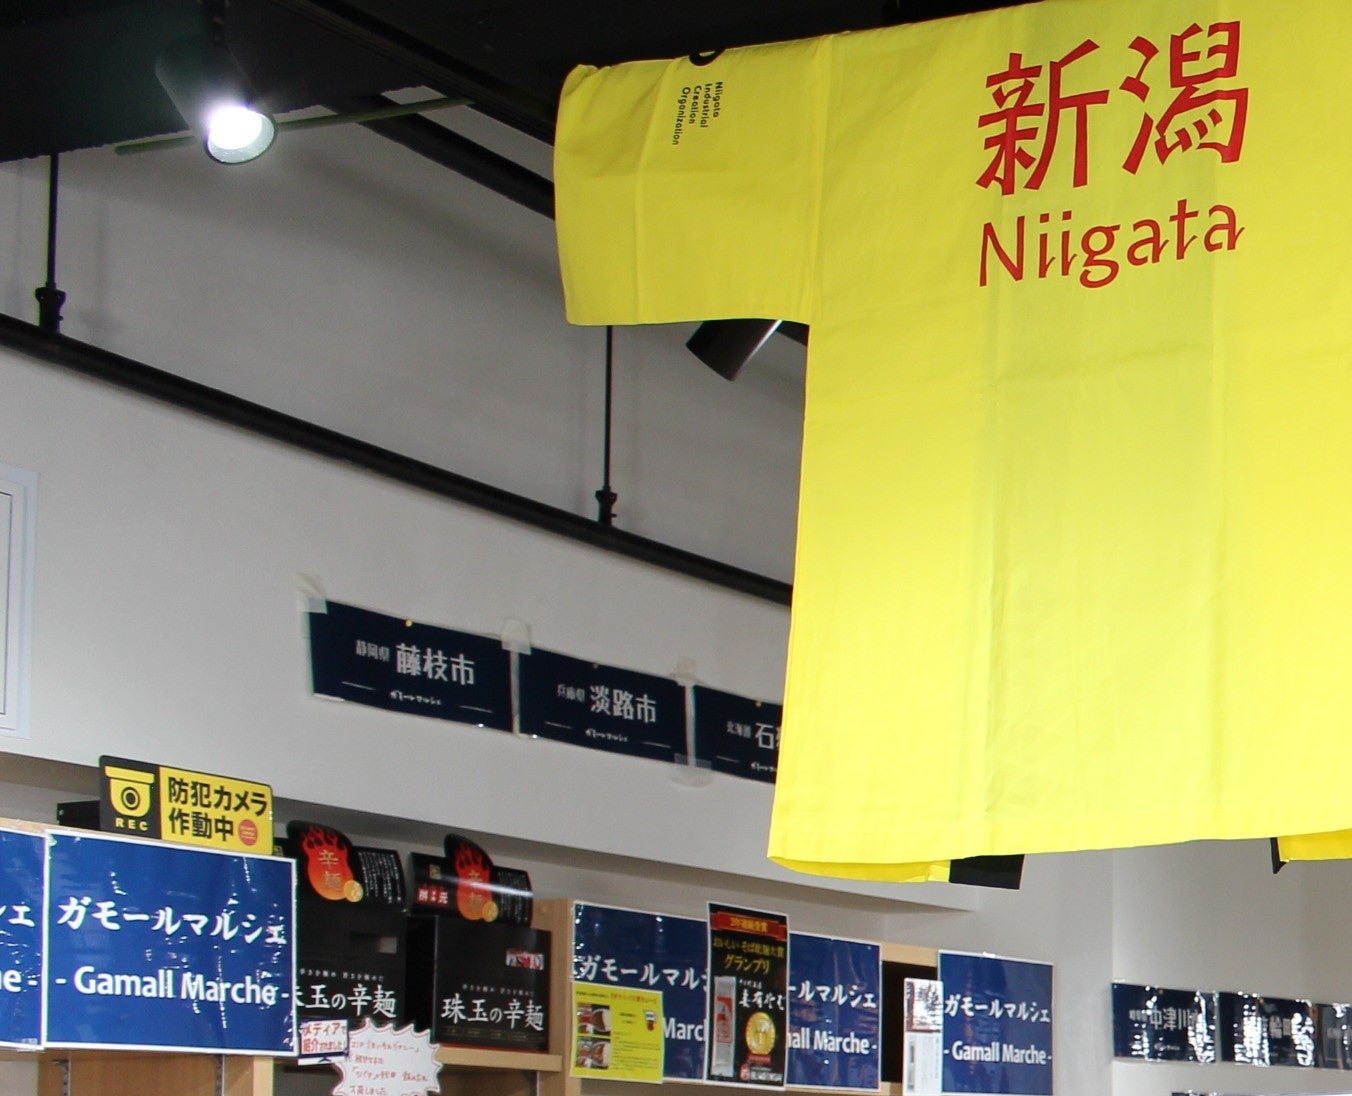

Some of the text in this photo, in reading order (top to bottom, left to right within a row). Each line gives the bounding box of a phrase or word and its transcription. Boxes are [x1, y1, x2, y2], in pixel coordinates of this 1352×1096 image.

[672, 86, 691, 145] Organization
[688, 85, 702, 124] Creation
[700, 83, 712, 128] Industrial
[712, 81, 723, 118] Niigata
[976, 20, 1249, 196] 新潟
[978, 199, 1247, 289] Niigata
[395, 643, 475, 686] 藤枝市
[588, 684, 657, 724] 淡路市
[168, 776, 269, 817] 防犯カメラ
[115, 817, 150, 832] REC
[168, 807, 234, 842] 作動中
[57, 894, 288, 945] ガモールマルシェ
[724, 953, 771, 976] グランプリ
[72, 965, 276, 1005] Gamall Marche
[441, 992, 545, 1032] 珠玉の辛麺
[944, 993, 1051, 1024] ガモールマルシェ
[1149, 1007, 1200, 1032] 中津川
[813, 1029, 870, 1055] Marche
[952, 1039, 1047, 1066] Gamall Marche
